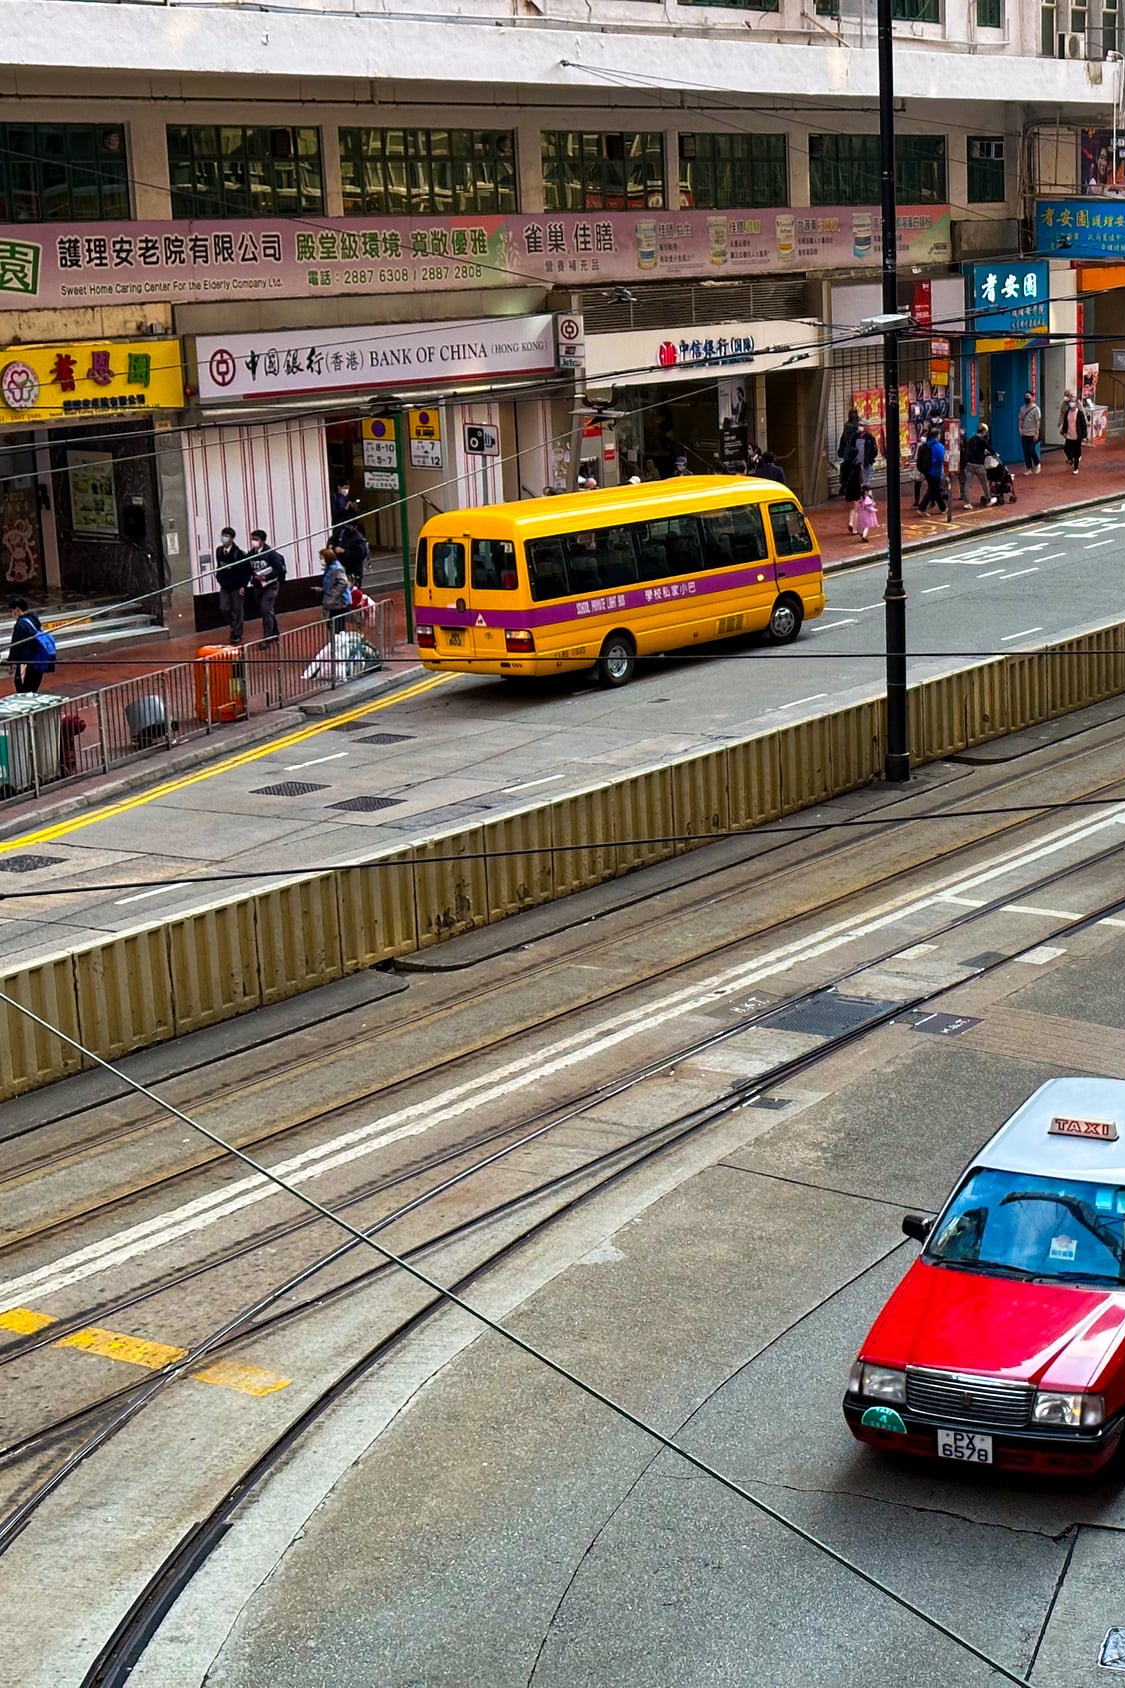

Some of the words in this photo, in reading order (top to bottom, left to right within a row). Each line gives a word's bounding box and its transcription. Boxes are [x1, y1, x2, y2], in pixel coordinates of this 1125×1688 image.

[57, 233, 283, 269] 護理安老院有限公司
[296, 231, 401, 261] 殿堂級環境
[411, 227, 488, 257] 寬敞優雅
[522, 223, 567, 255] 雀巢
[573, 222, 615, 253] 佳膳
[344, 269, 374, 285] 2887
[379, 267, 409, 283] 6308
[422, 266, 449, 281] 2887
[455, 264, 482, 279] 2808
[61, 285, 87, 296] Sweet
[89, 284, 113, 295] Home
[115, 283, 142, 295] Caring
[144, 281, 170, 293] Center
[173, 281, 186, 291] For
[188, 280, 201, 290] the
[203, 280, 230, 292] Elderly
[232, 279, 267, 290] Company
[369, 349, 412, 368] BANK
[416, 346, 436, 363] OF
[440, 342, 487, 361] CHINA
[491, 341, 519, 356] (HONG
[521, 339, 548, 354] KONG)
[375, 443, 395, 453] 8-10
[431, 456, 441, 466] 12
[644, 581, 697, 602] 學校私家小巴
[1054, 1117, 1111, 1136] TAXI
[953, 1432, 976, 1450] PX
[942, 1443, 989, 1463] 6578
